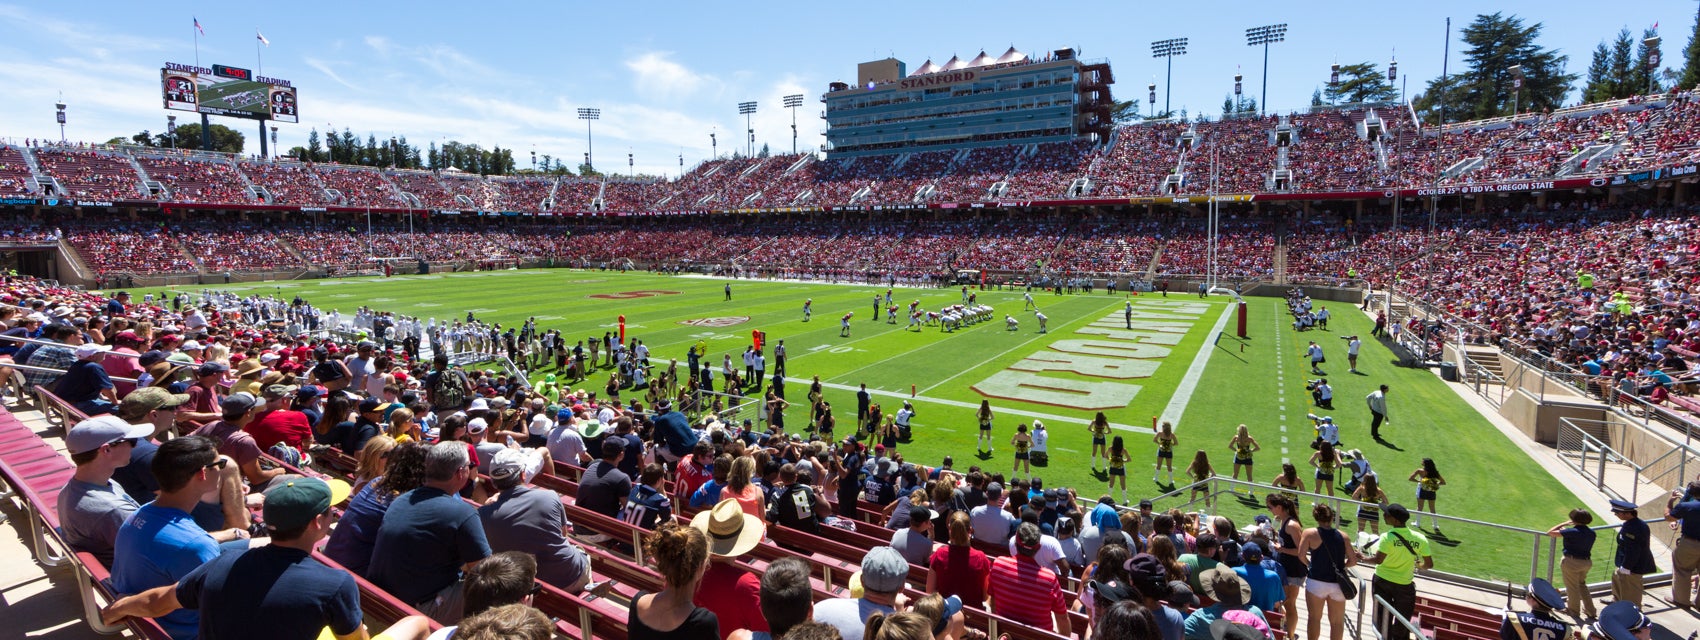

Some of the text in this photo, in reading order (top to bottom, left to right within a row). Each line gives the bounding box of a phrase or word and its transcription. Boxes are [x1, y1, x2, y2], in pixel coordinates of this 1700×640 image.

[165, 62, 291, 87] STANFORD STADIUM
[901, 71, 975, 89] STANFORD
[179, 81, 192, 90] 21
[1497, 183, 1528, 191] OREGON
[1531, 181, 1554, 189] STATE
[791, 489, 812, 520] 8
[623, 501, 646, 527] 50
[1393, 540, 1420, 549] VEOR
[1521, 615, 1564, 631] UC DAVIS
